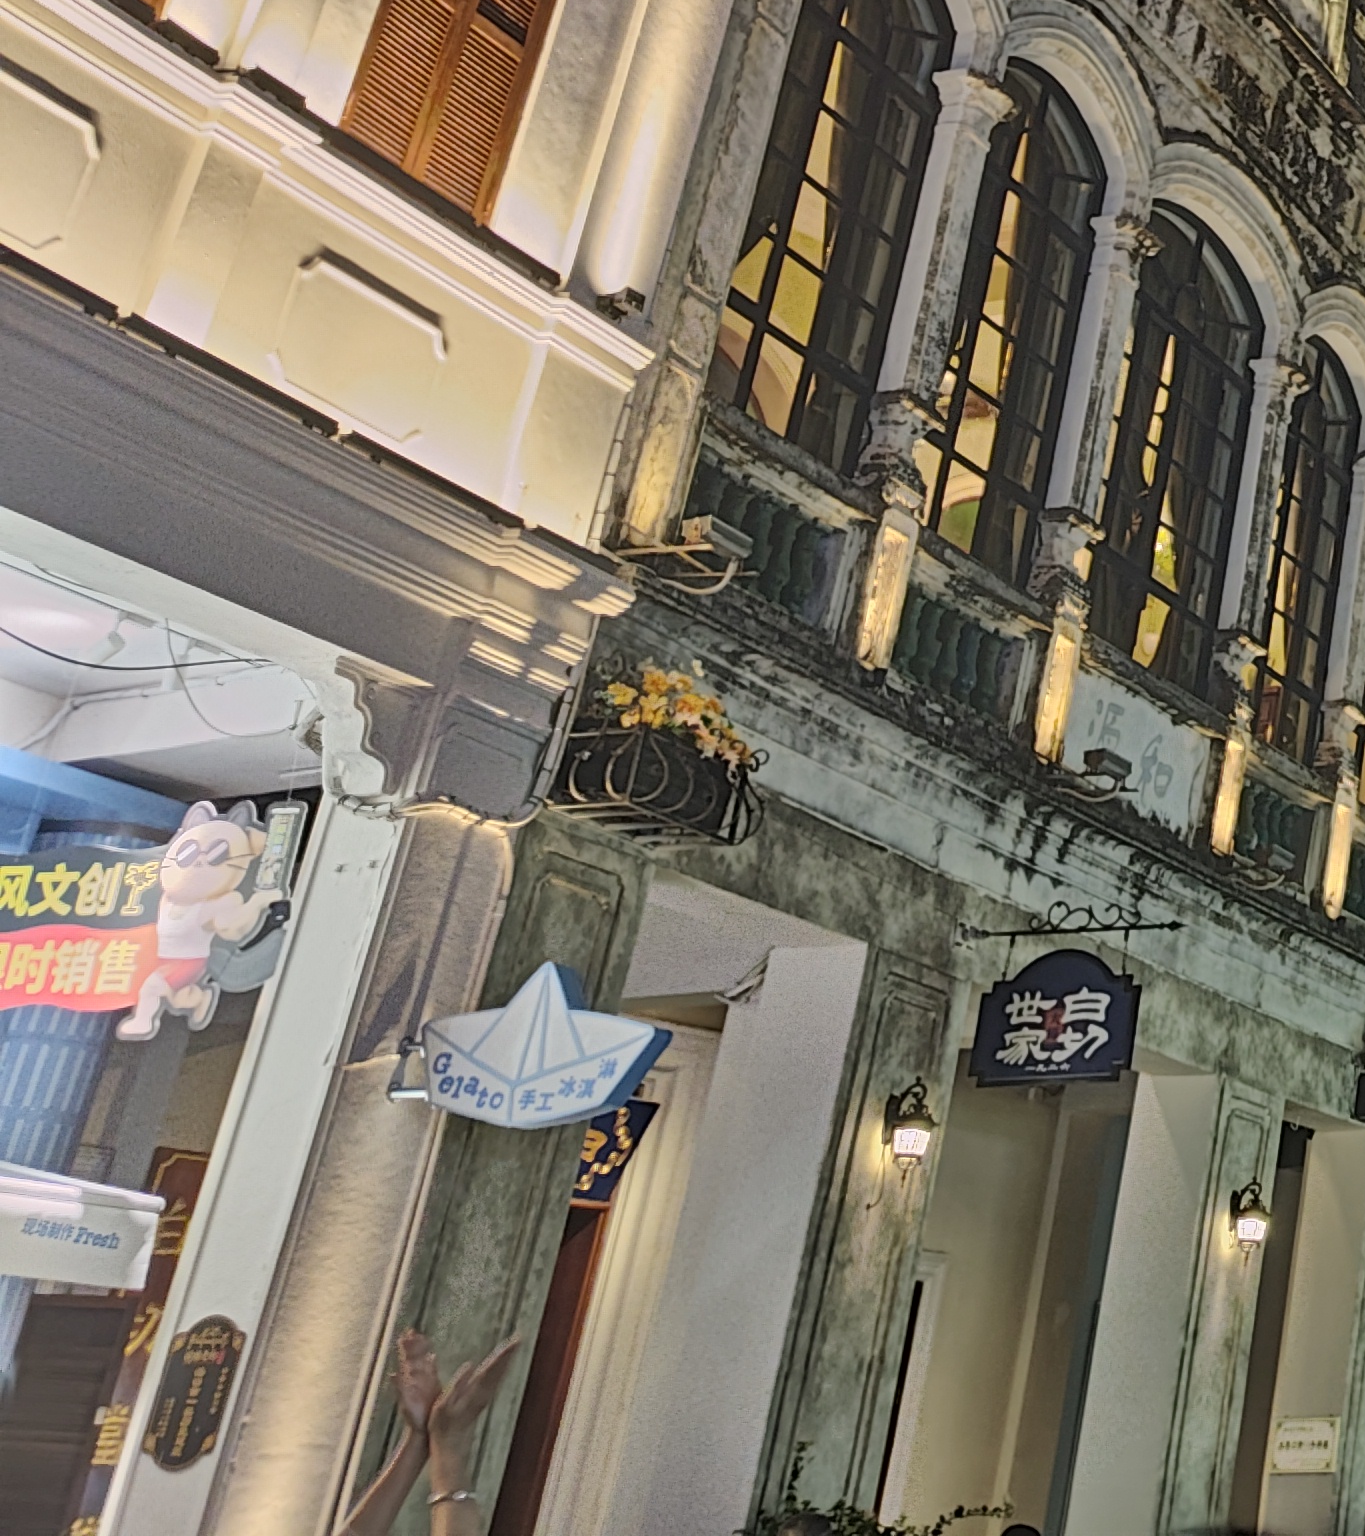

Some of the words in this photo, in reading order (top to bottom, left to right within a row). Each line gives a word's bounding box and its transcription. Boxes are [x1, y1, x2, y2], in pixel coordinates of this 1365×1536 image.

[432, 1052, 504, 1110] Gelato
[518, 1057, 618, 1111] 手工冰淇淋
[20, 1217, 75, 1241] 现场制作
[73, 1225, 121, 1250] Fresh
